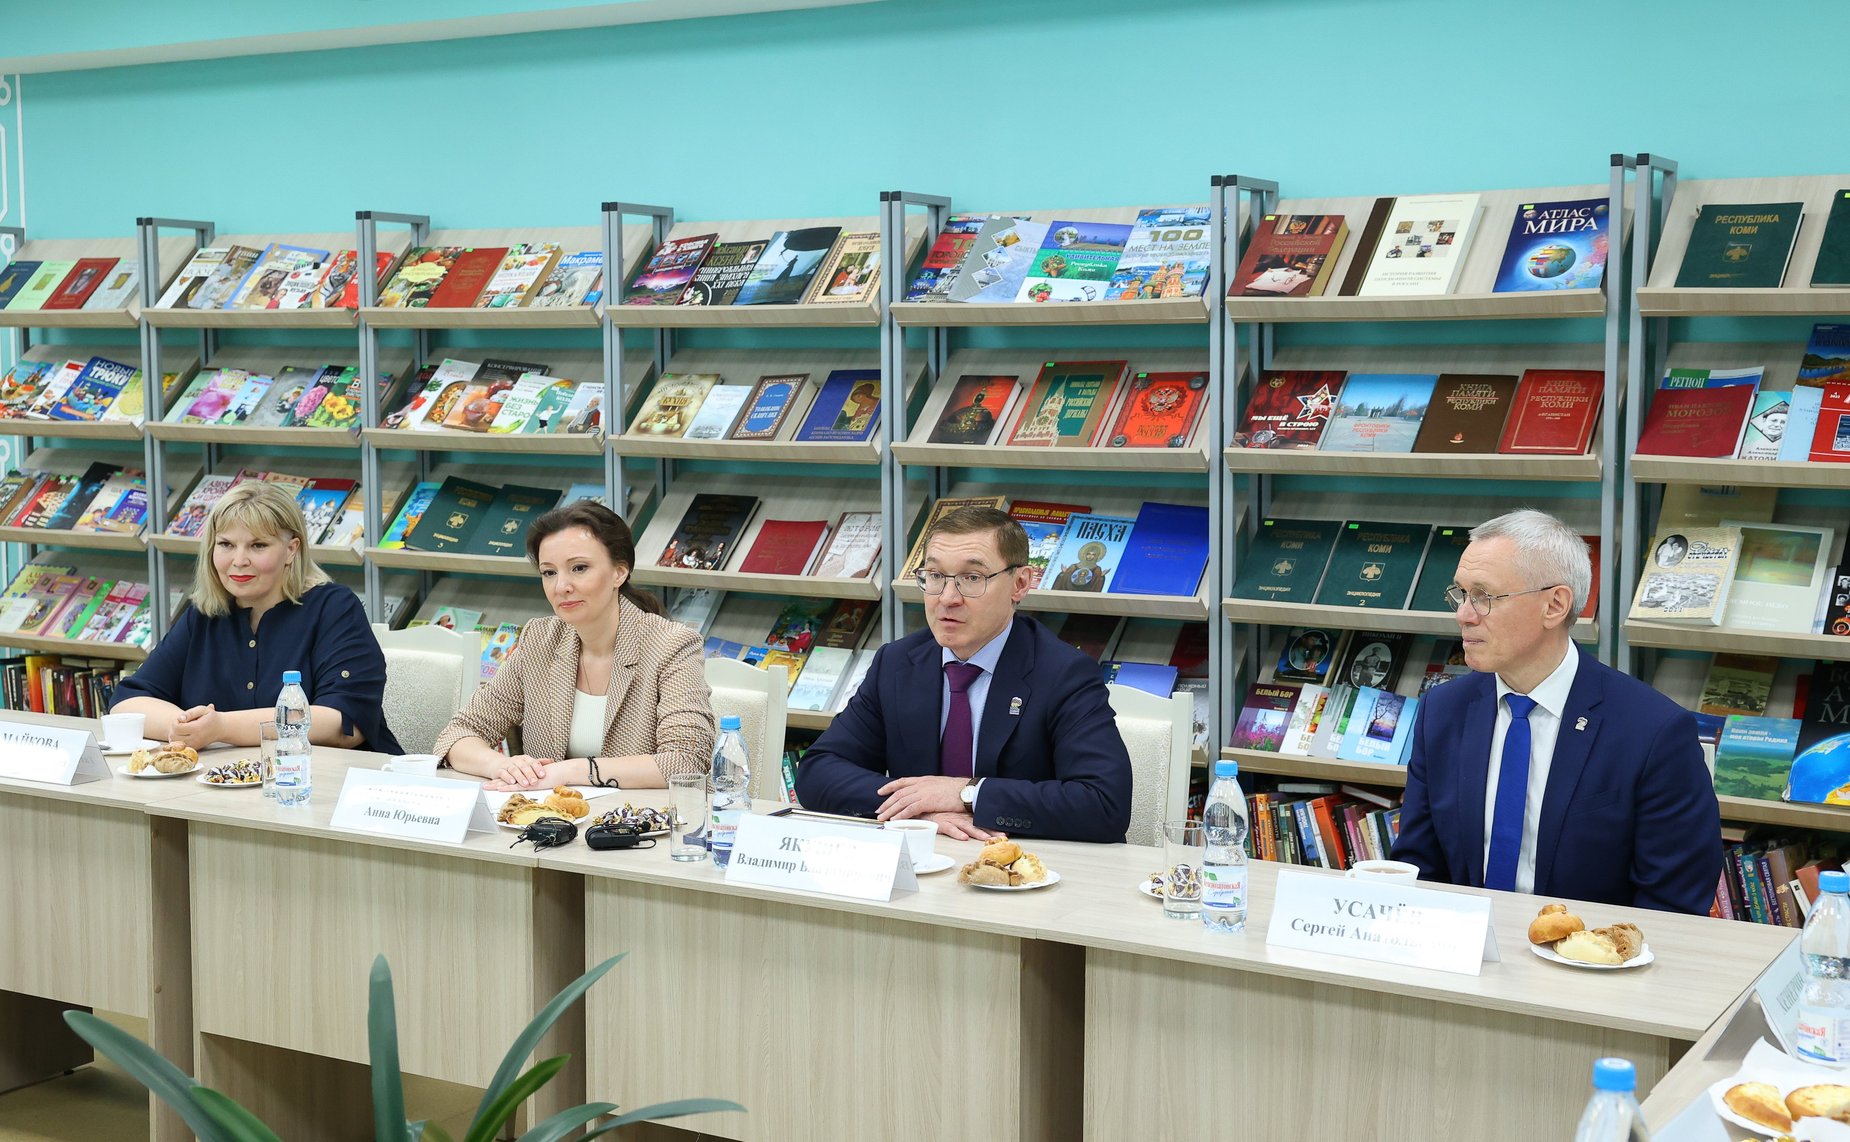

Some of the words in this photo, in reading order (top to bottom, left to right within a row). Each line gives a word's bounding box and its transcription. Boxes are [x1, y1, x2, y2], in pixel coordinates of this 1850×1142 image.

[1538, 207, 1591, 220] АТЛАС
[1715, 214, 1780, 224] РЕСПУБЛИКА
[1522, 216, 1599, 234] МИРА
[1729, 225, 1758, 235] КОМИ
[1150, 229, 1204, 242] 100
[1129, 244, 1157, 253] МЕСТ
[1160, 243, 1175, 251] НА
[1459, 383, 1493, 391] КНИГА
[1545, 380, 1582, 389] КНИГА
[1669, 376, 1706, 388] РЕГИОН
[1451, 390, 1497, 398] ПАМЯТИ
[1538, 386, 1587, 394] ПАМЯТИ
[1529, 395, 1590, 403] РЕСПУБЛИКИ
[1453, 403, 1484, 411] КОМИ
[1540, 401, 1575, 409] КОМИ
[1076, 521, 1128, 543] ПАСХА
[1367, 544, 1393, 553] КОМИ
[1255, 688, 1280, 697] БЕЛЫЙ
[1279, 690, 1295, 699] БОР
[363, 806, 391, 819] Анна
[392, 809, 442, 826] Юрьевна
[736, 852, 798, 874] Владимир
[1290, 917, 1346, 938] Сергей
